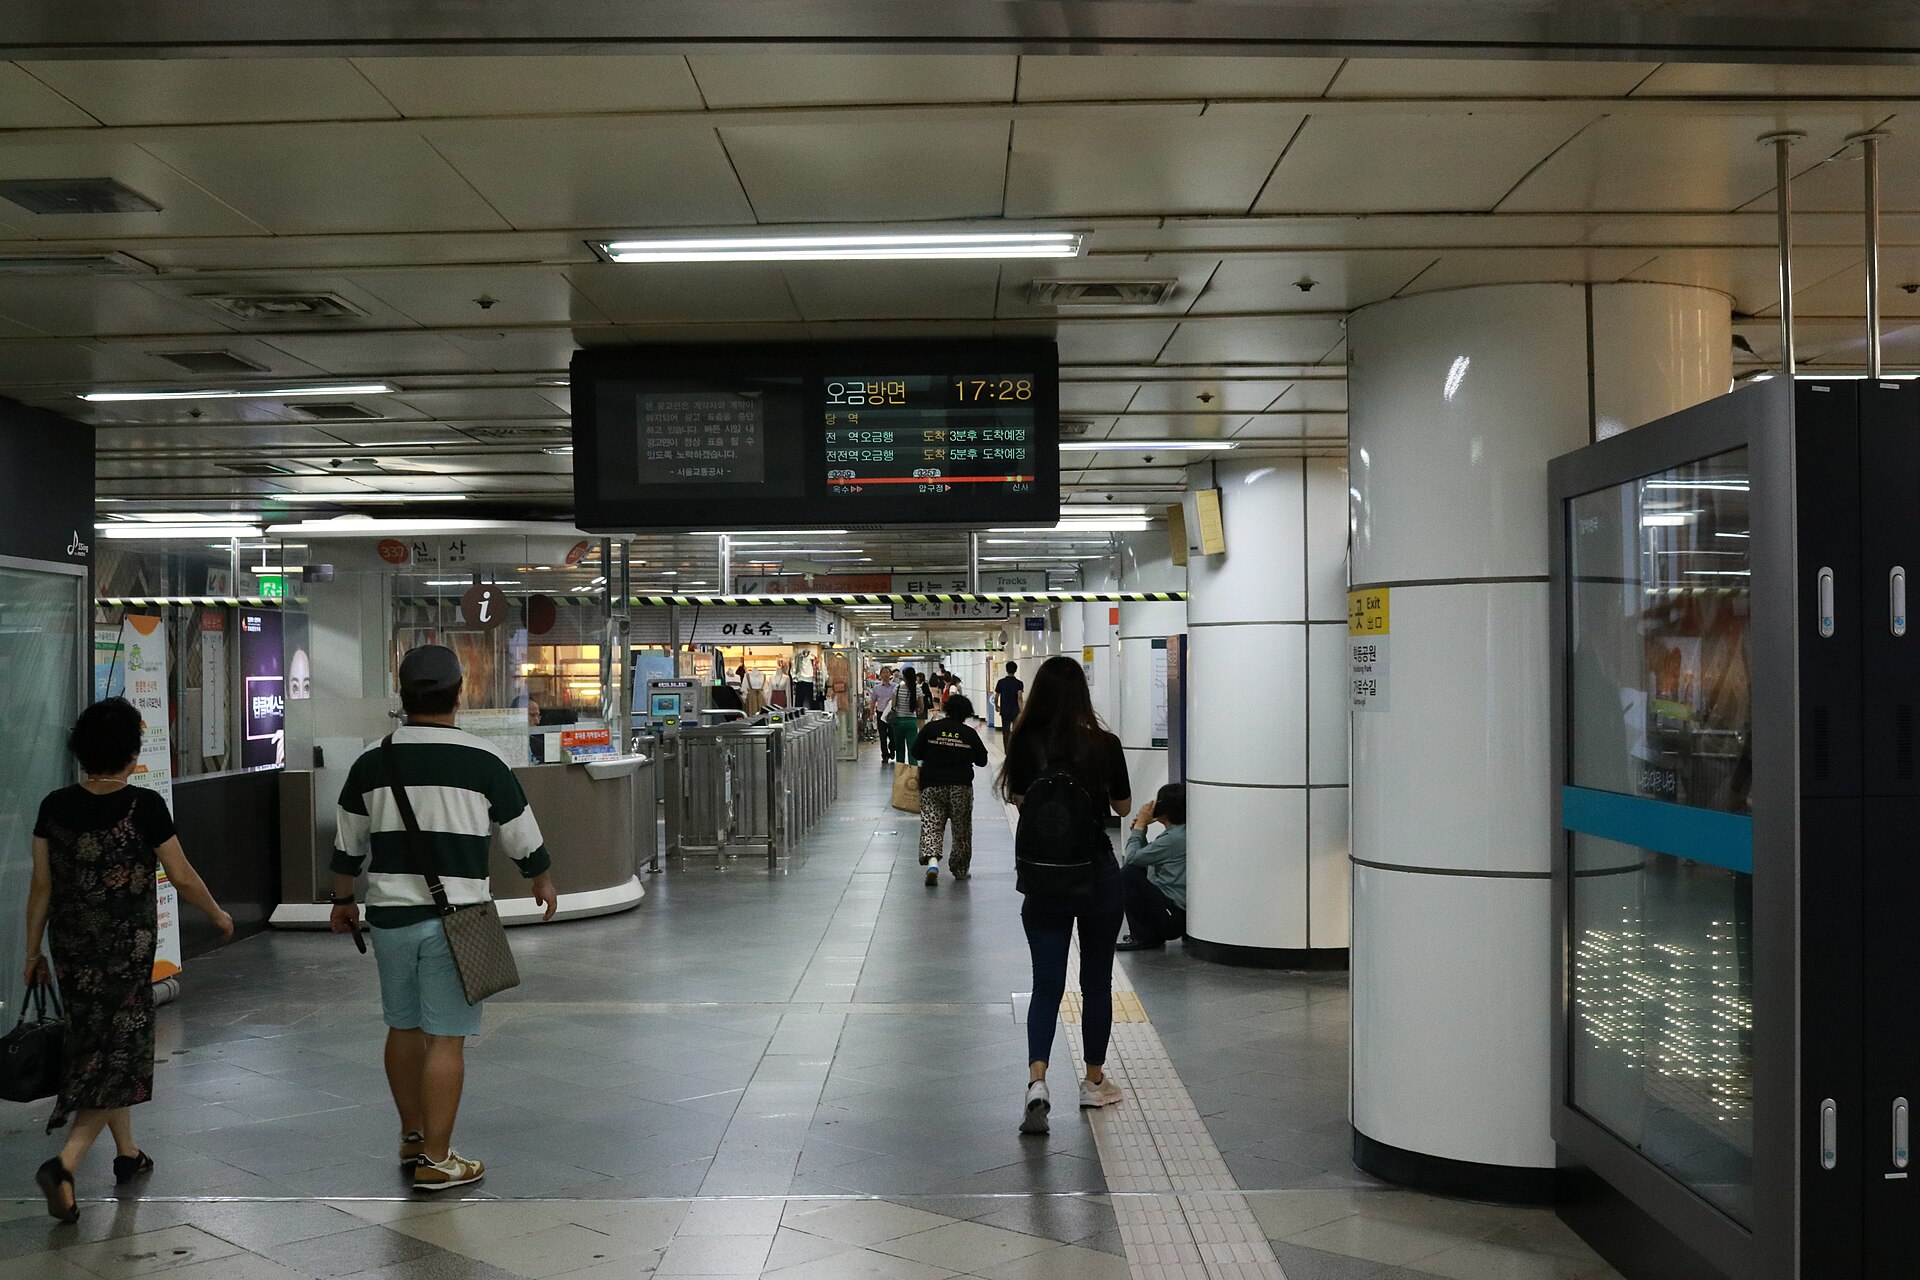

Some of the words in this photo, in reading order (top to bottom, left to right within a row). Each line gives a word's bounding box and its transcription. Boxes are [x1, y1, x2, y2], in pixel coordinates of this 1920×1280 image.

[826, 381, 906, 405] 오금방면
[955, 380, 1032, 401] 17:28
[825, 413, 837, 426] 당
[848, 412, 859, 424] 역
[826, 431, 837, 443] 전
[848, 431, 859, 443] 역
[860, 431, 894, 443] 오금행
[923, 430, 946, 442] 도착
[950, 430, 978, 442] 3분후
[982, 429, 1026, 441] 도착예정
[826, 450, 859, 462] 전전역
[860, 450, 894, 462] 오금행
[923, 449, 946, 461] 도착
[950, 449, 978, 461] 5분후
[982, 448, 1026, 460] 도착예정
[677, 467, 724, 476] 서울교통공사
[918, 484, 944, 493] 압구정
[381, 547, 404, 558] 337
[907, 582, 942, 592] 타는
[1367, 597, 1381, 610] Exit
[722, 623, 738, 636] 이
[742, 624, 754, 635] &
[759, 621, 772, 636] 슈
[1367, 616, 1382, 630] 出口
